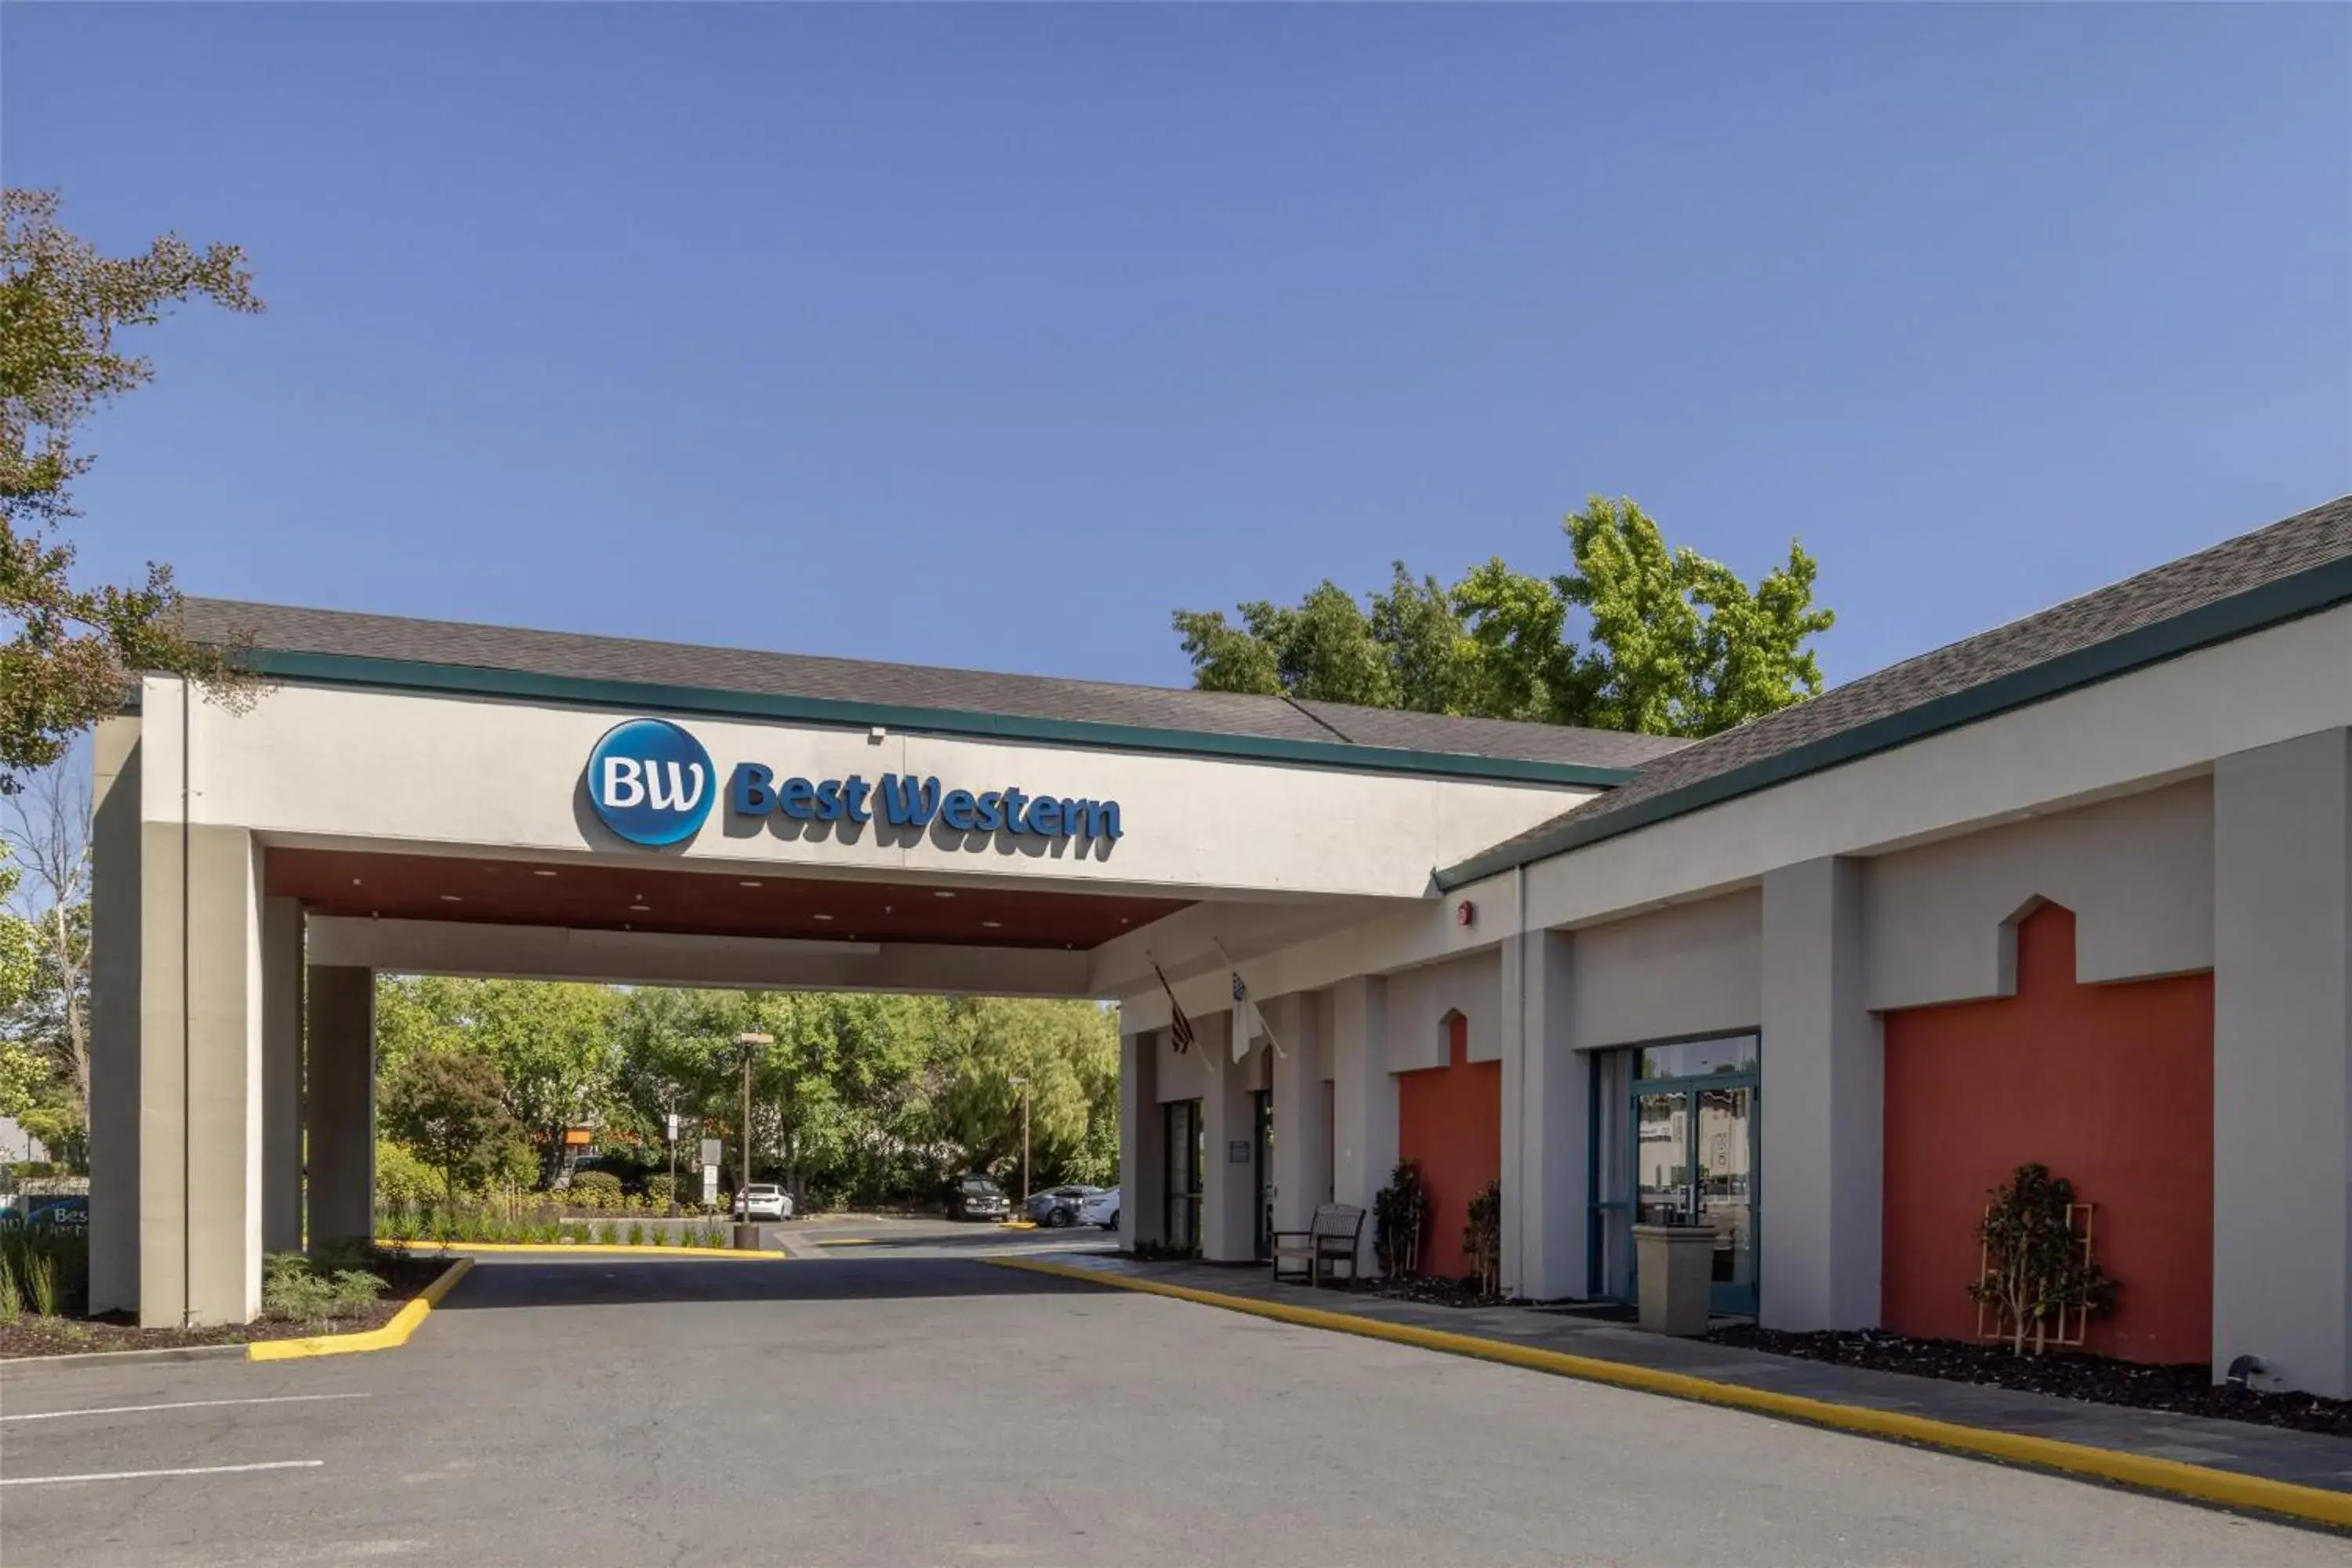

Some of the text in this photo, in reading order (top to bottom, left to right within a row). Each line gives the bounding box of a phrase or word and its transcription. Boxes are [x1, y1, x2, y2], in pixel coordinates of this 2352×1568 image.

[604, 757, 705, 811] BW
[734, 762, 1124, 840] Best Western
